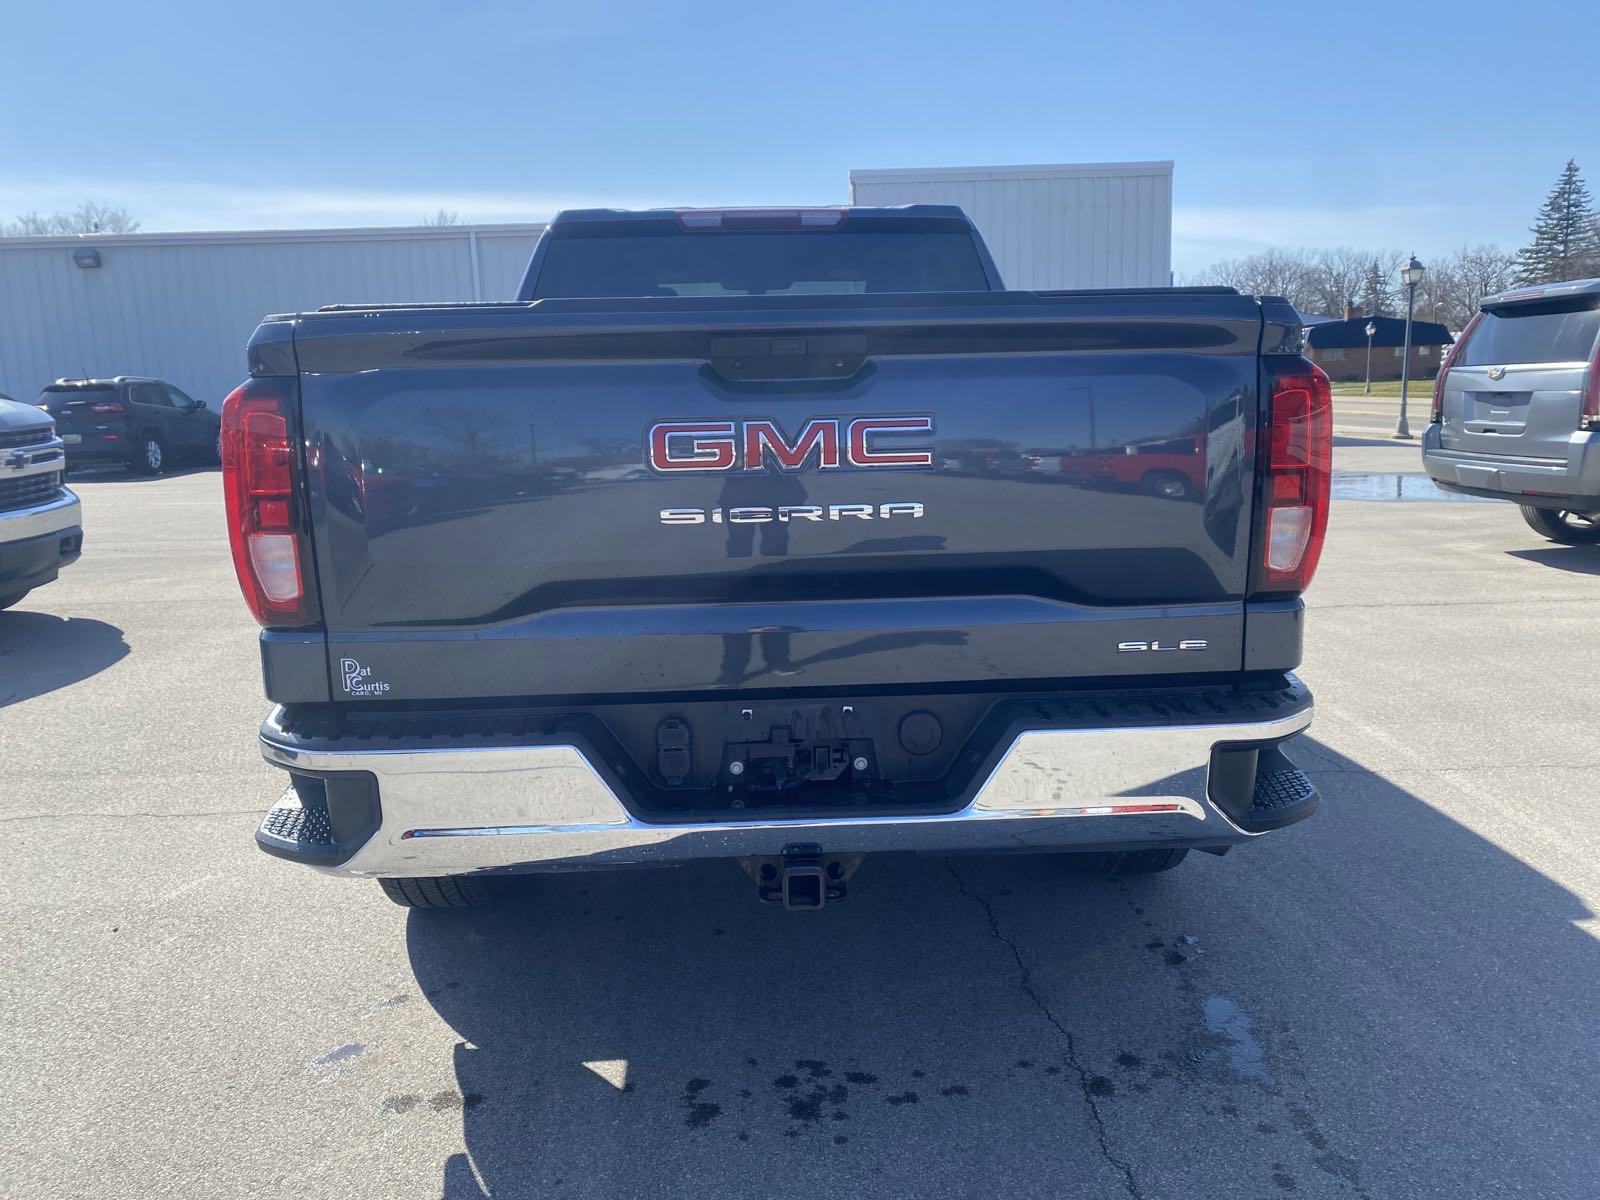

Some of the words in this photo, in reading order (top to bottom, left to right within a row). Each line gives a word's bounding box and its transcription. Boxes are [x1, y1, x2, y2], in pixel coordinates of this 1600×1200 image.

[649, 415, 934, 473] GMC
[659, 502, 924, 525] SIERRA
[1117, 639, 1208, 652] SLE
[340, 658, 371, 691] Pat
[349, 674, 390, 691] Curtis
